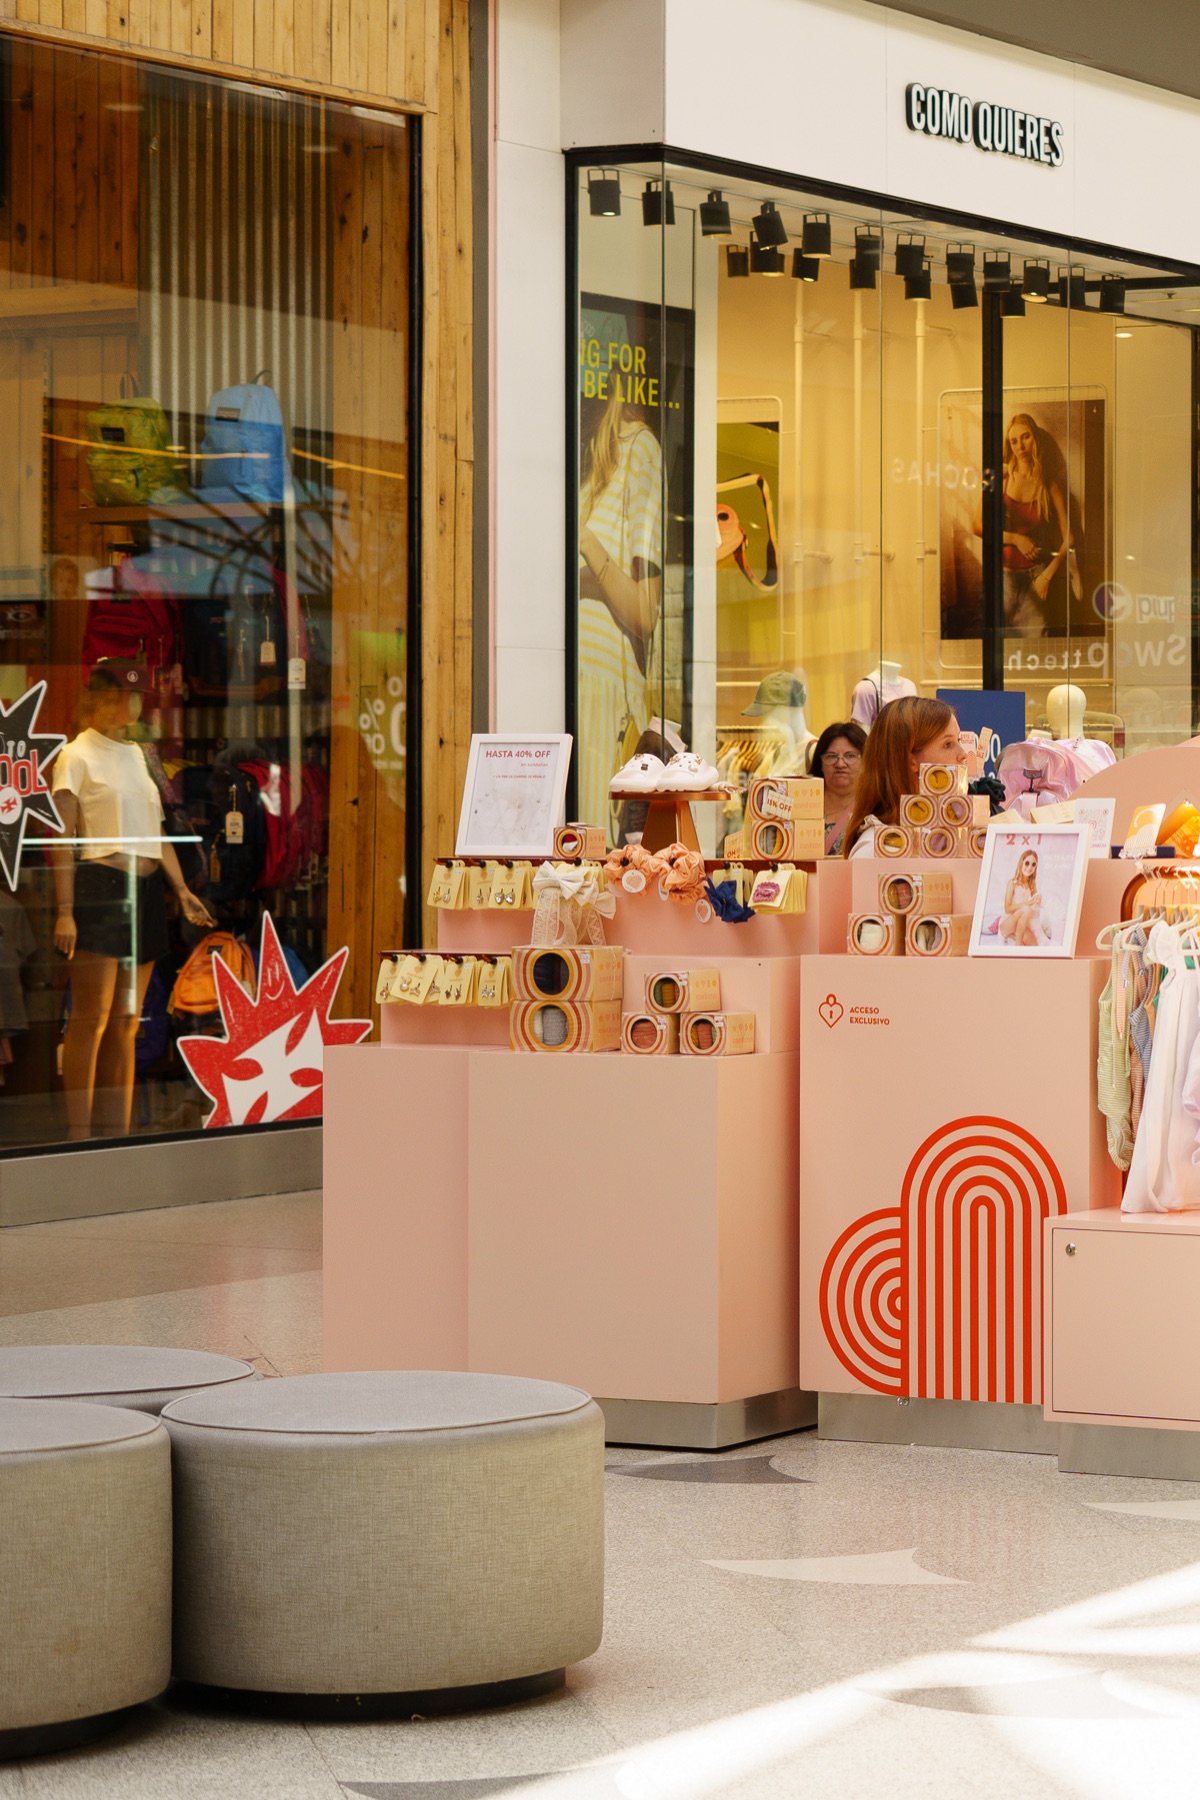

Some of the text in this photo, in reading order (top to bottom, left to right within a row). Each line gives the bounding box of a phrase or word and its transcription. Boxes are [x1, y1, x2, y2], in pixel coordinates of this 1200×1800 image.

[906, 83, 1064, 167] COMO QUIERES
[608, 342, 646, 374] FOR
[584, 370, 608, 400] BE
[767, 798, 793, 813] 15% OFF
[1006, 834, 1015, 846] 2
[850, 1006, 880, 1014] ACCESO
[850, 1016, 890, 1025] EXCLUSIVO
